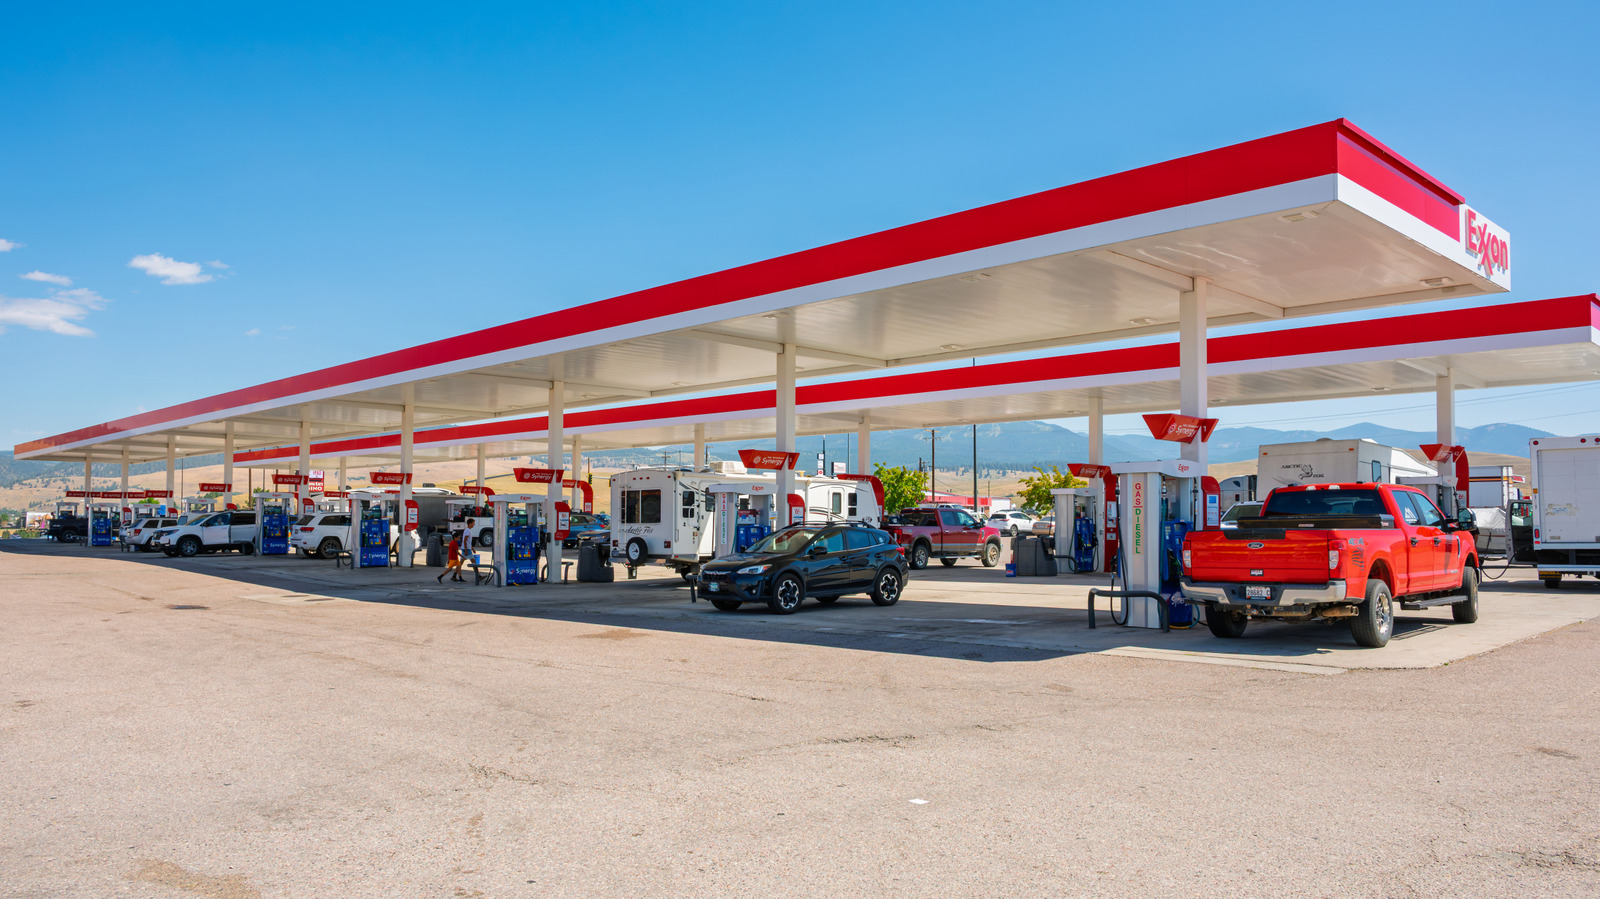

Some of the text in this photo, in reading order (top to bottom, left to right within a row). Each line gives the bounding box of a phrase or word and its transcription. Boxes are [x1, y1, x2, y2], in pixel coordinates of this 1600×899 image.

[1467, 209, 1509, 276] Exxon
[1175, 425, 1197, 437] Synergy
[762, 457, 784, 466] Synergy
[1178, 463, 1190, 473] Exxon
[531, 473, 552, 481] Synergy
